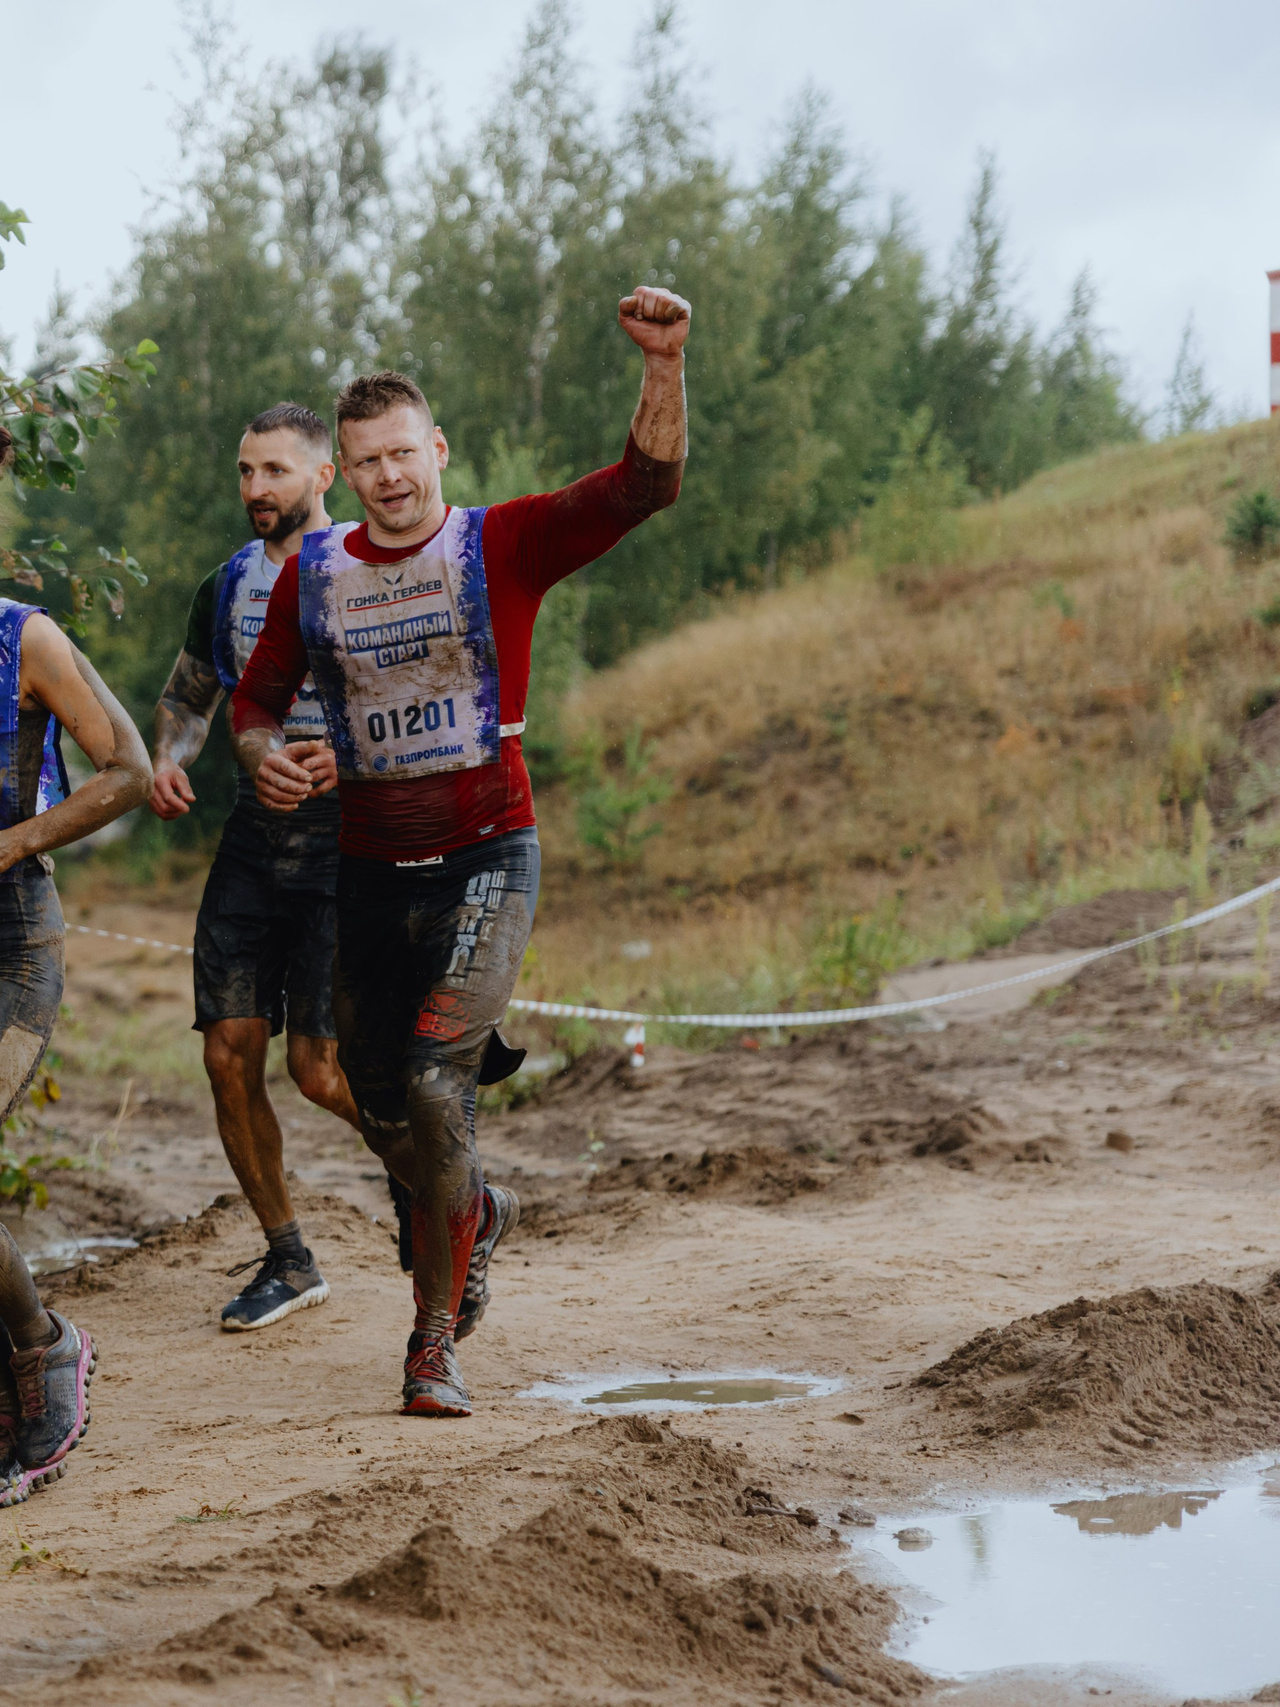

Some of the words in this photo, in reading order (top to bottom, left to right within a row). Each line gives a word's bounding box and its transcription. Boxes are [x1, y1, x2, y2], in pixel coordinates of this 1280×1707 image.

[346, 592, 390, 609] ГОНКА
[393, 579, 443, 600] ГЕРОЕВ
[347, 611, 450, 649] КОМАНДНЫЙ
[378, 641, 426, 666] СТАРТ
[367, 698, 456, 742] 01201
[395, 744, 465, 766] ГАЗПРОМБАНК
